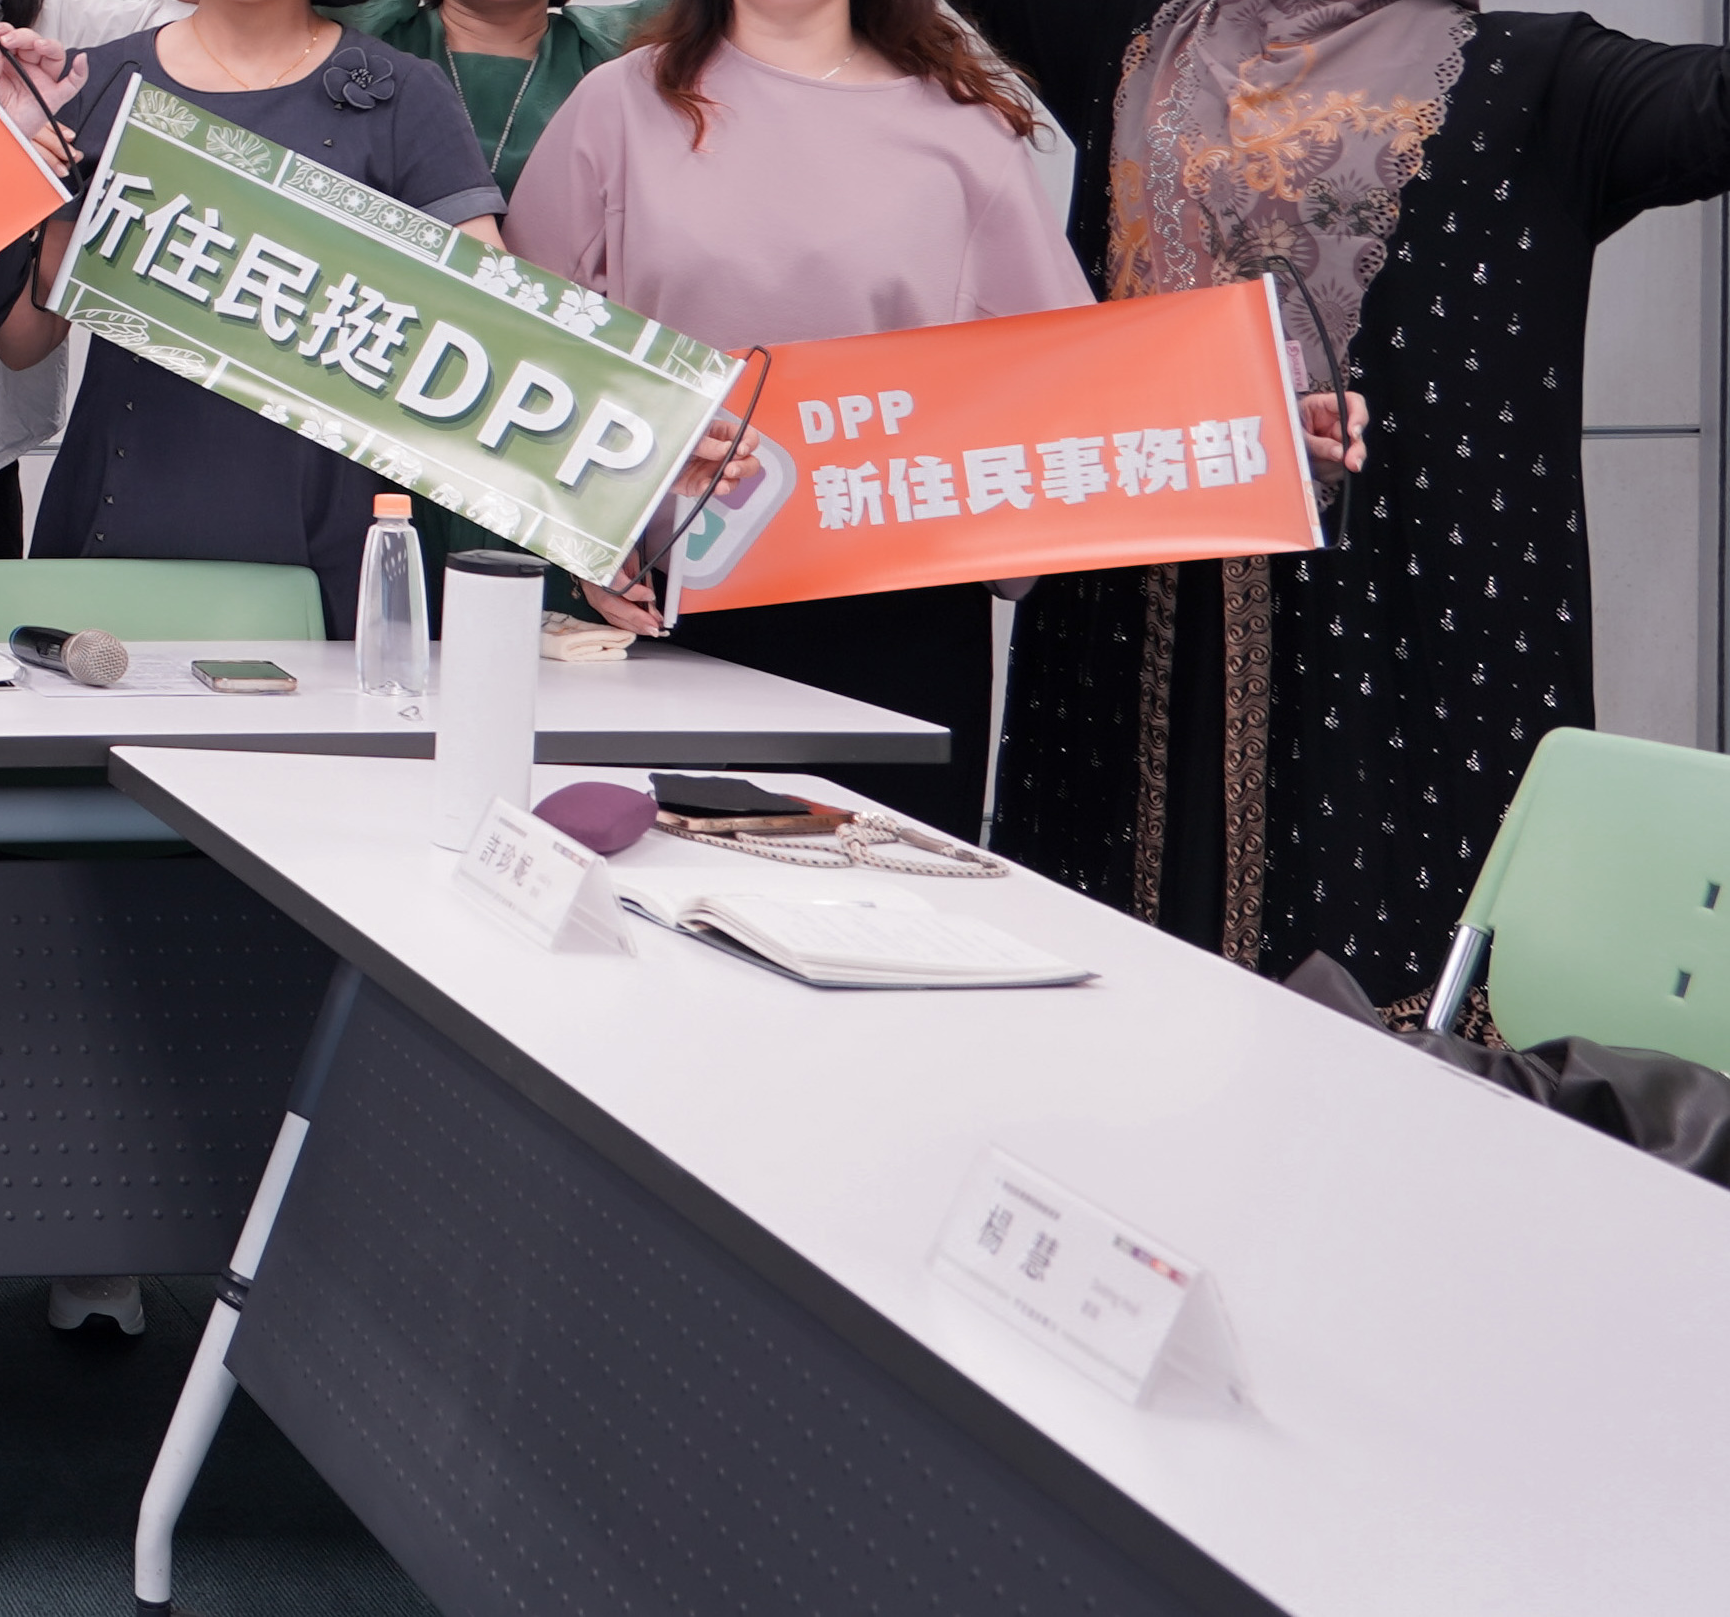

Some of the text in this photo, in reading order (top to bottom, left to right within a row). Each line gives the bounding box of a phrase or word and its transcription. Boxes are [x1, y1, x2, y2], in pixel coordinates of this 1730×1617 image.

[798, 389, 914, 444] DPP
[811, 415, 1268, 531] 新住民事務部
